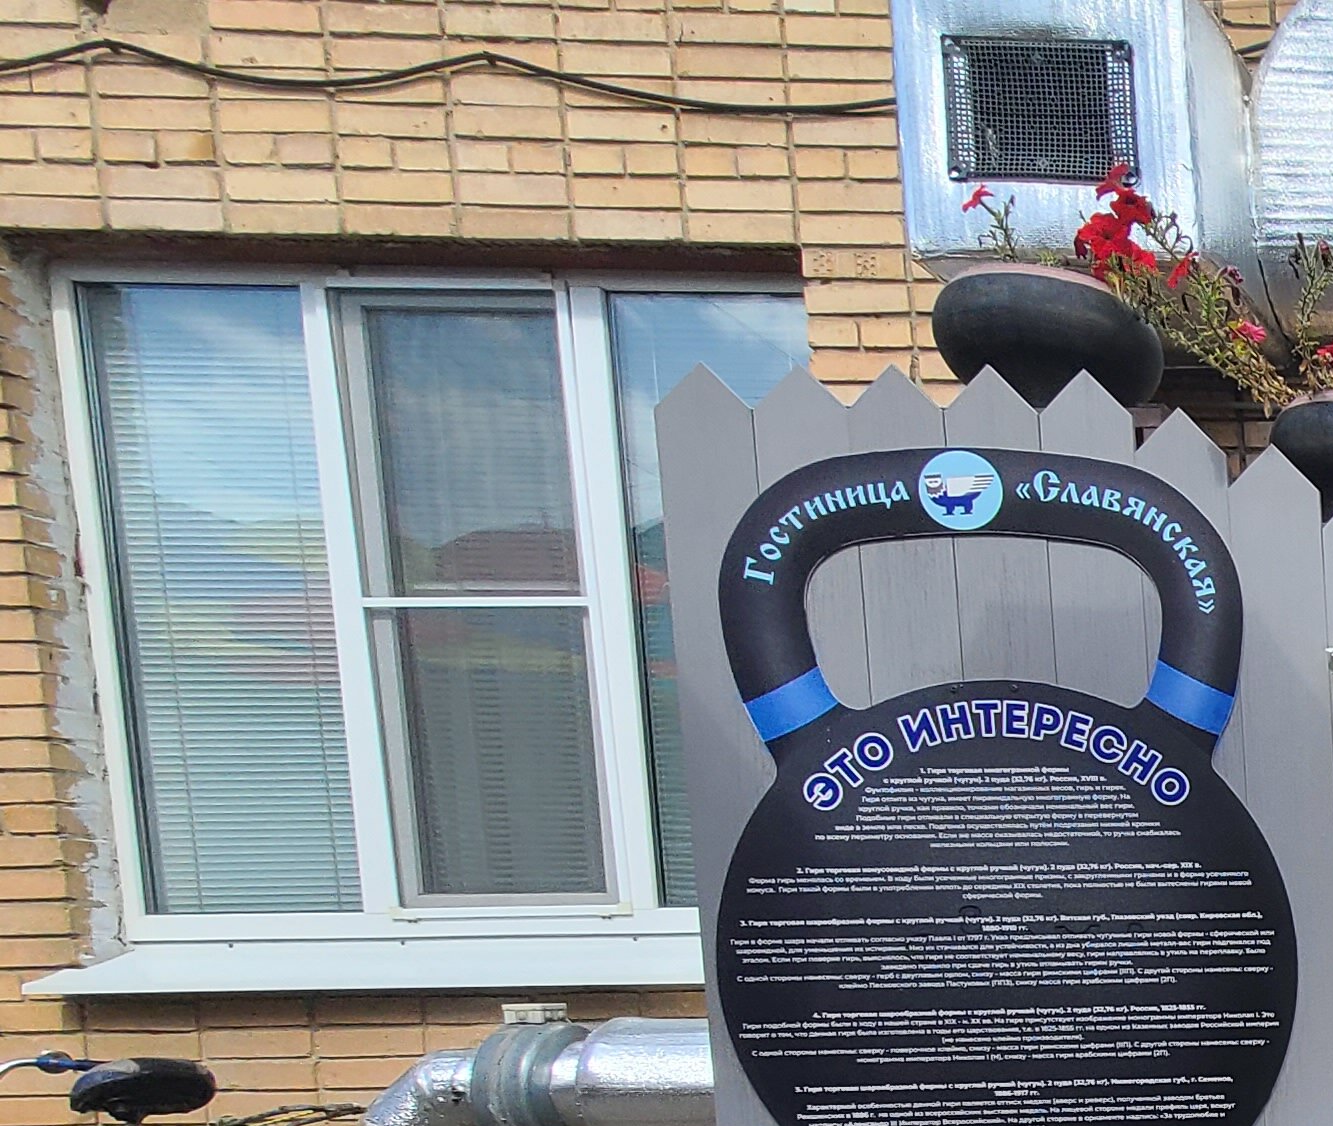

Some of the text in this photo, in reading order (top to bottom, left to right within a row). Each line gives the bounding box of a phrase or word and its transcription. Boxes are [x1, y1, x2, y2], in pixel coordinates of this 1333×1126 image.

[743, 470, 1216, 615] Гостиница «Славянская»
[803, 698, 1191, 812] ЭТО ИНТЕРЕСНО
